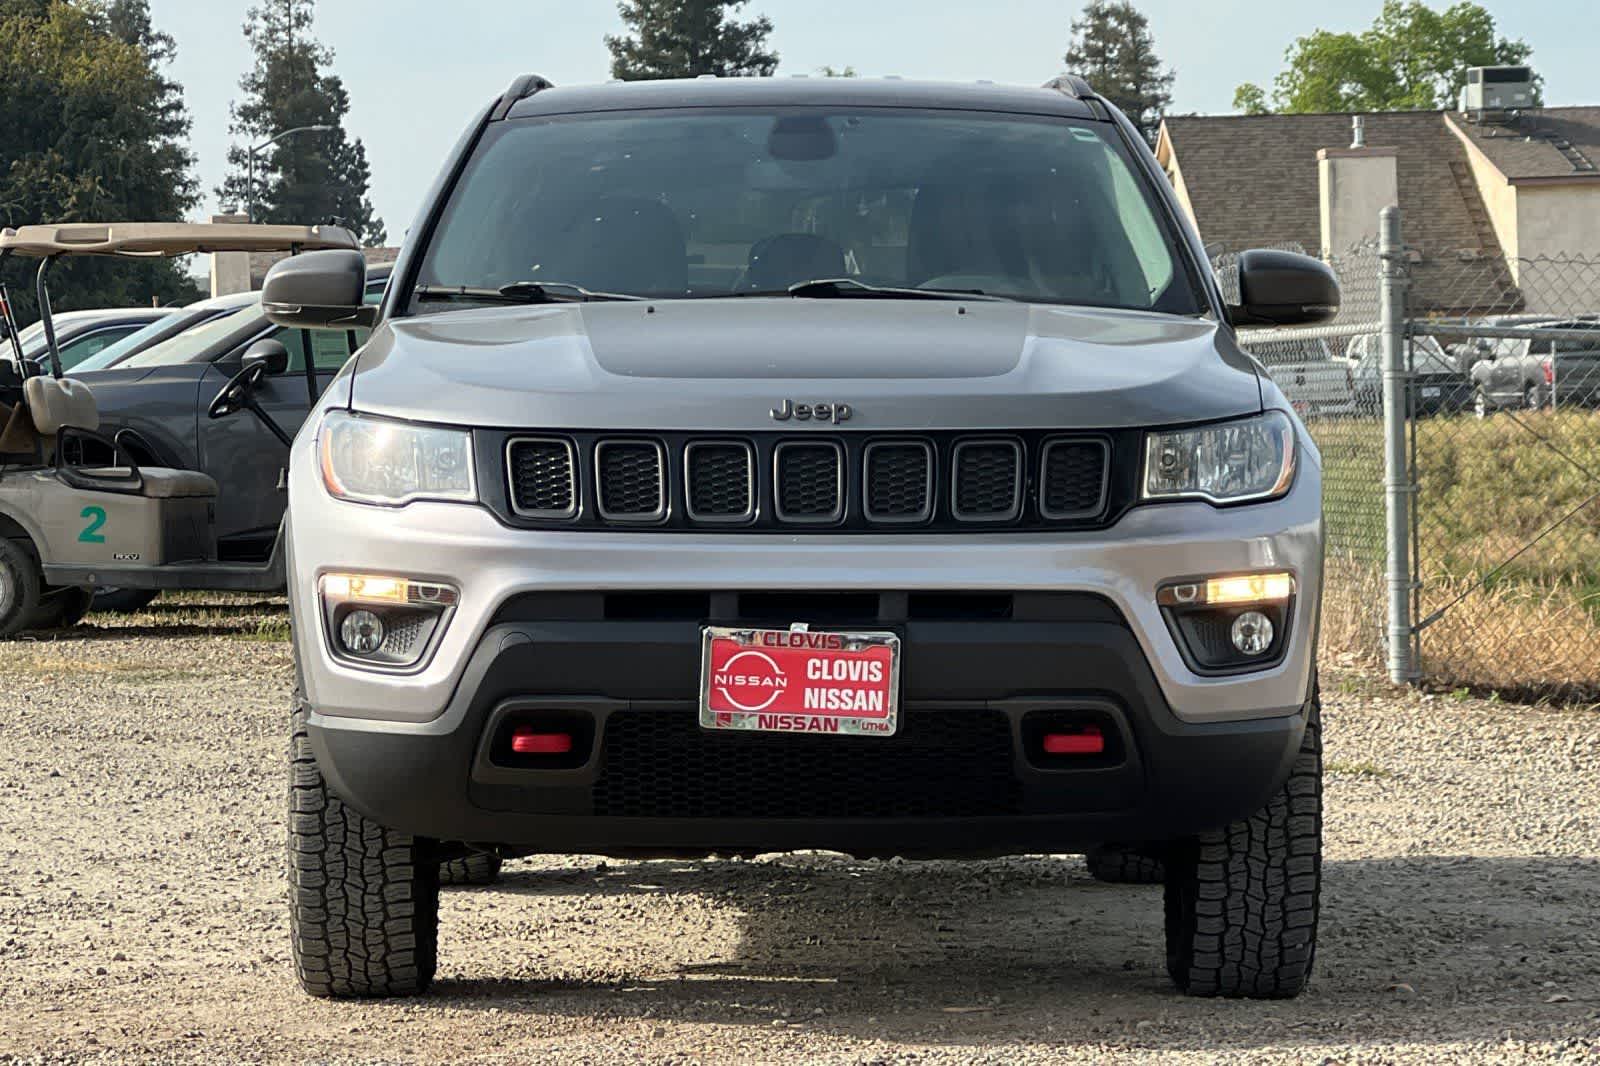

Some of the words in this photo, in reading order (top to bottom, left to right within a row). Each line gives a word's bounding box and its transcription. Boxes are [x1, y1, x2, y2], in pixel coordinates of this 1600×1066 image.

[769, 400, 852, 424] Jeep
[78, 506, 106, 543] 2
[763, 632, 841, 649] CLOVIS
[715, 675, 787, 687] NISSAN
[807, 658, 882, 682] CLOVIS
[804, 687, 883, 711] NISSAN
[758, 714, 839, 732] NISSAN
